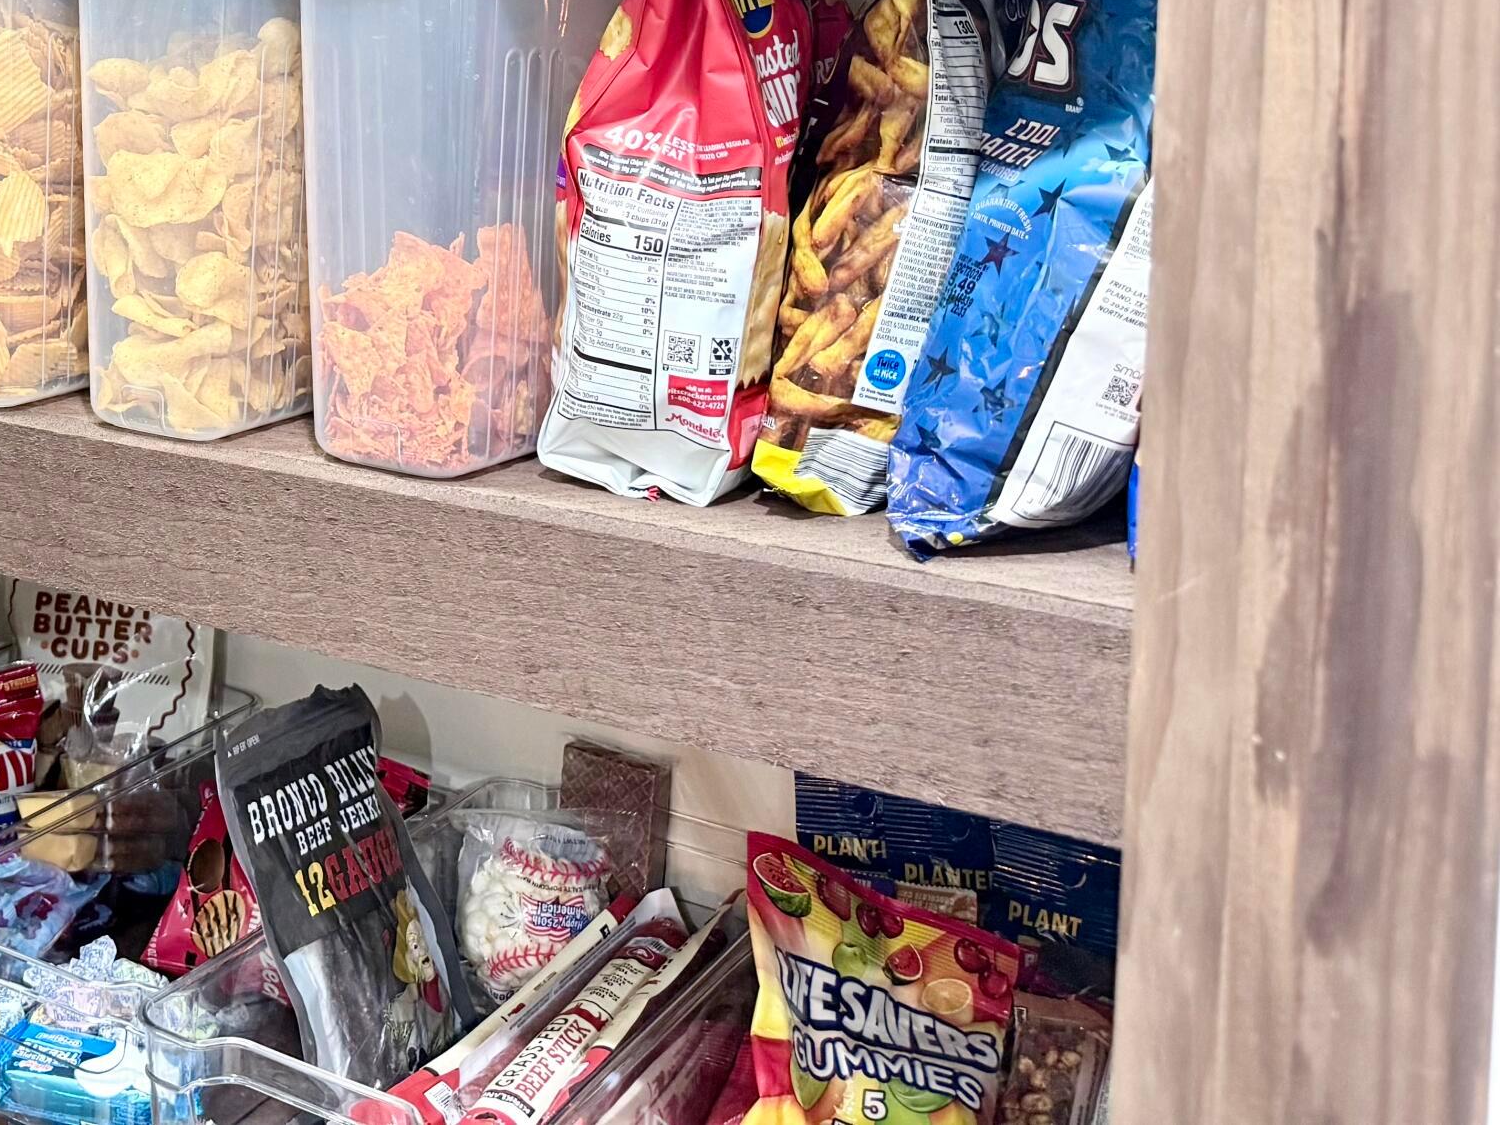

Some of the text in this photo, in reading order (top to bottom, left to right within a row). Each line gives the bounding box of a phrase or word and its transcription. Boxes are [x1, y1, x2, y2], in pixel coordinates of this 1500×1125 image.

[953, 20, 974, 35] 130
[752, 30, 801, 76] asted
[604, 126, 662, 152] 40%
[666, 135, 751, 154] LESS LEADING REGULAR
[929, 137, 952, 146] Protein
[1005, 118, 1061, 147] COOL
[662, 144, 685, 161] FAT
[928, 154, 950, 163] Vitamin
[979, 160, 1021, 182] FLAVORED
[580, 172, 634, 197] Nutrition
[637, 190, 675, 210] Facts
[598, 195, 669, 218] servings container
[630, 214, 649, 225] chips
[975, 197, 1033, 233] GUARANTEED FRESH
[580, 222, 663, 254] Calories 150
[973, 212, 1026, 240] UNTIL PRINTED DATE
[900, 256, 924, 267] POWDER
[902, 247, 922, 257] BROWN
[1106, 288, 1132, 304] PLANO,
[1097, 305, 1123, 321] NORTH
[596, 339, 636, 355] Added Sugars
[876, 356, 900, 369] Twice
[33, 613, 152, 644] BUTTER
[51, 638, 129, 664] CUPS
[4, 674, 36, 691] PROTEIN
[248, 773, 328, 846] BRONCO
[296, 817, 332, 856] BEEF
[814, 834, 887, 861] PLANT
[295, 861, 336, 918] 12
[904, 863, 991, 890] PLANTE
[532, 915, 559, 928] 250th
[538, 902, 581, 919] America!
[1008, 900, 1083, 938] PLANT
[495, 1017, 569, 1088] GRASS-FED
[515, 1019, 592, 1101] BEEF STICK
[792, 1029, 986, 1111] GUMMIES
[862, 1088, 888, 1121] 5
